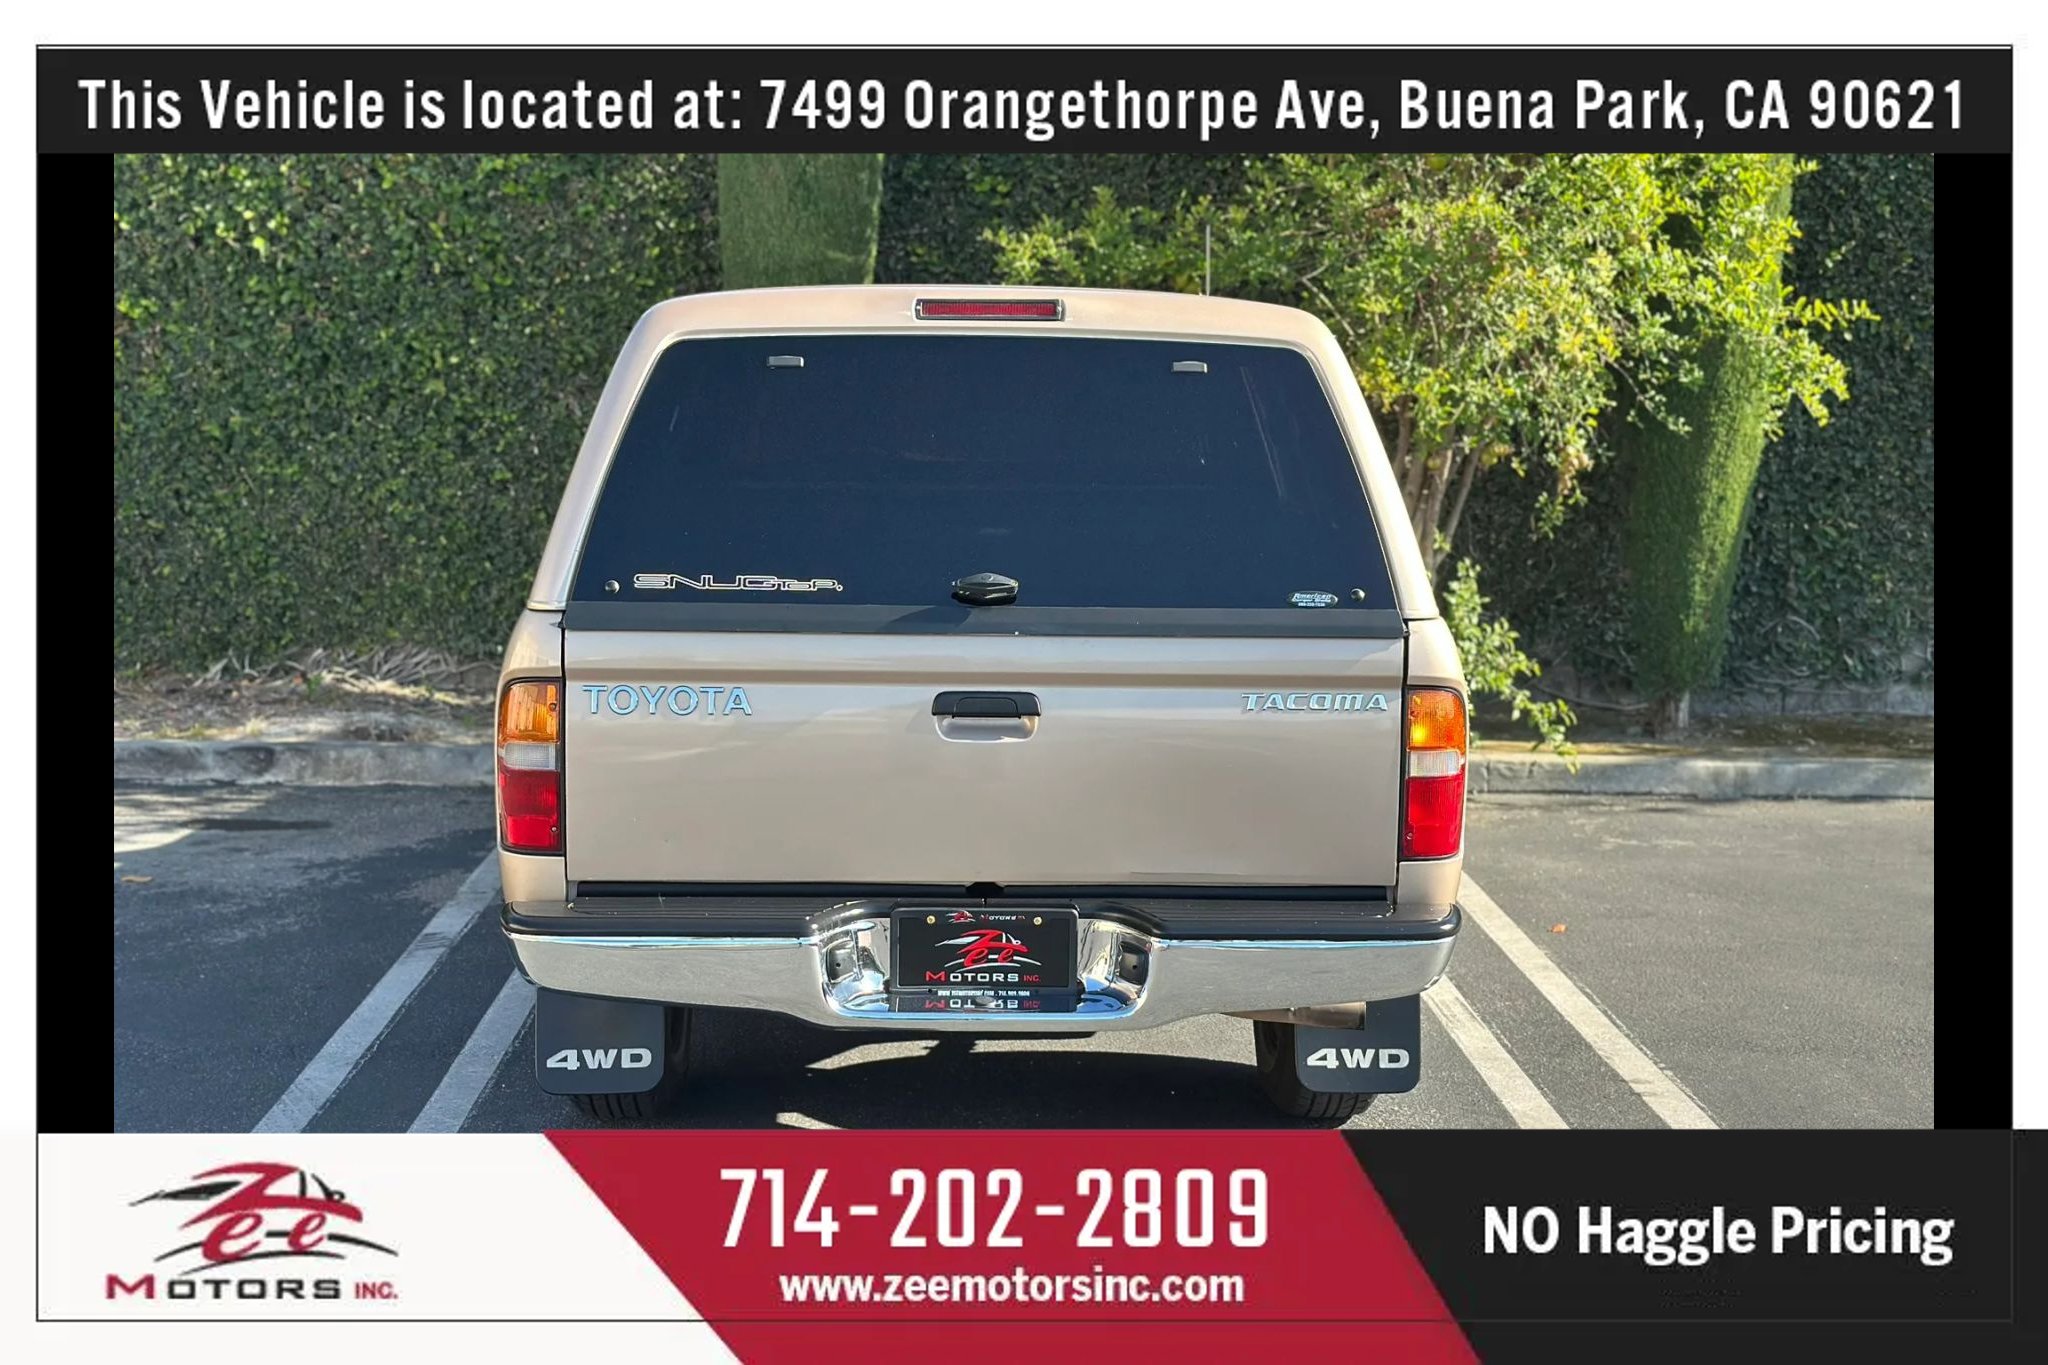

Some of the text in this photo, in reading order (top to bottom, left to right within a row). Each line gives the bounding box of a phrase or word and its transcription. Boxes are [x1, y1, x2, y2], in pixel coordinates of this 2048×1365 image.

[582, 684, 752, 715] TOYOTA
[1241, 693, 1388, 711] TACOMA
[925, 971, 1019, 982] MOTORS
[546, 1048, 652, 1070] 4WD
[1306, 1048, 1410, 1069] 4WD
